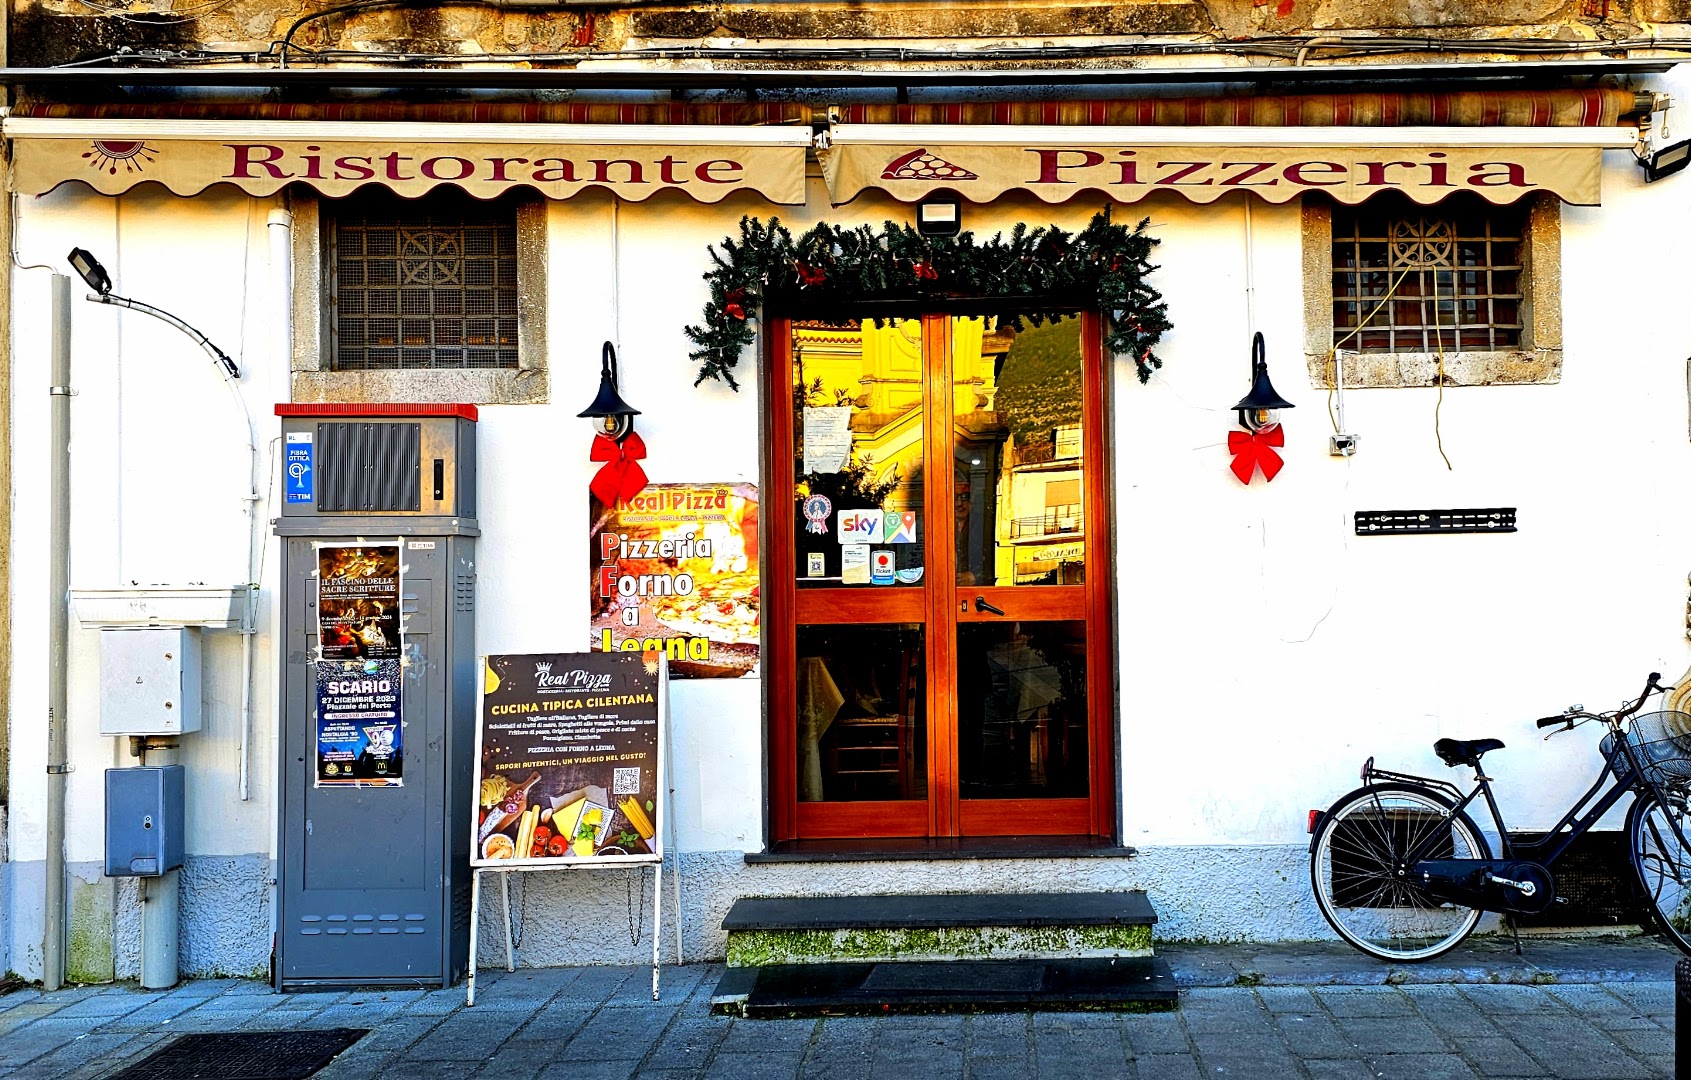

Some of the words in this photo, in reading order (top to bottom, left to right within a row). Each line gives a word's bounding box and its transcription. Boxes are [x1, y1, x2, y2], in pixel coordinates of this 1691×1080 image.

[223, 143, 744, 185] Ristorante
[1025, 148, 1539, 189] Pizzeria
[672, 491, 726, 510] Pizza
[843, 514, 878, 535] sky
[601, 532, 712, 560] Pizzeria
[349, 585, 396, 593] SCRITTURE
[367, 577, 394, 585] DELLE
[601, 565, 694, 597] Forno
[621, 606, 640, 626] a
[328, 680, 391, 695] SCARIO
[534, 671, 569, 687] Real
[570, 669, 613, 688] Pizza
[334, 696, 374, 704] DICEMBRE
[491, 702, 539, 715] CUCINA
[542, 699, 583, 711] TIPICA
[586, 693, 654, 708] CILENTANA
[522, 759, 562, 768] AUTENTICI,
[620, 752, 647, 760] GUSTO!
